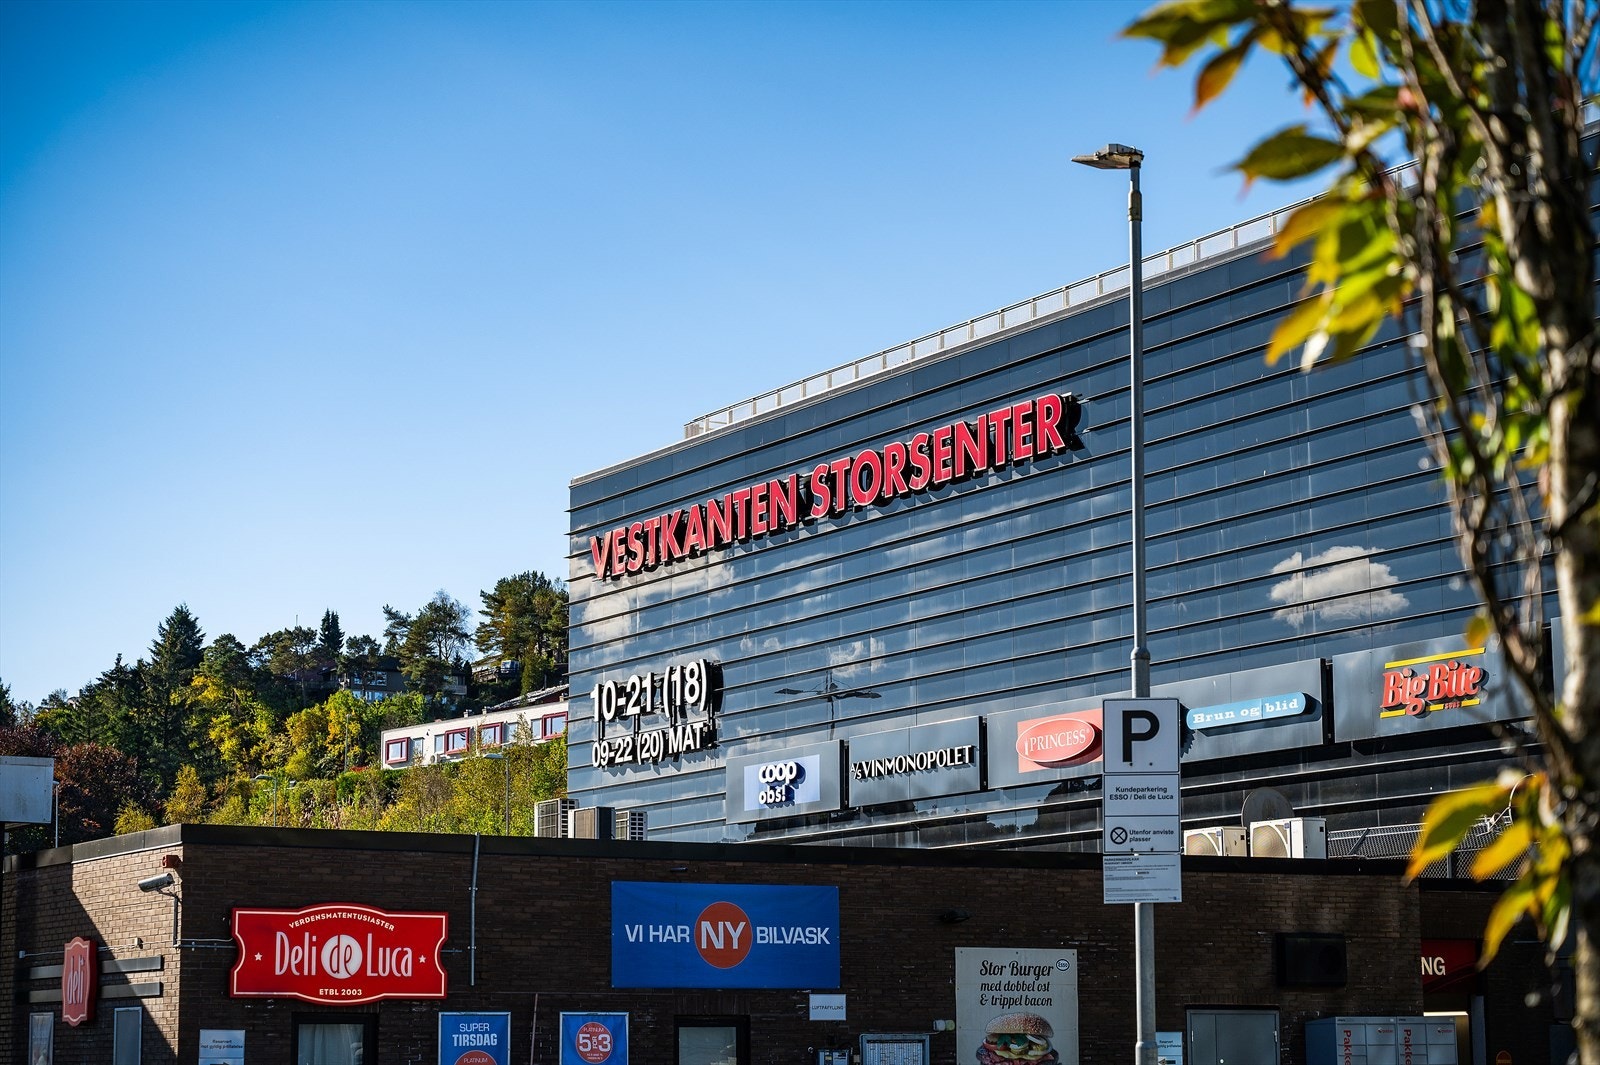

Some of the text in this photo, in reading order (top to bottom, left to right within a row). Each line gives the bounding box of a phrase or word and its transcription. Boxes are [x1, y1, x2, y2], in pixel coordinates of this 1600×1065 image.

[589, 392, 1065, 580] VESTKANTEN STORSENTER
[590, 658, 707, 722] 10-21 (18)
[1380, 660, 1483, 716] Big Bite
[1192, 698, 1299, 724] Brun og blid
[592, 721, 704, 768] 09-22 (20) MAT
[1029, 728, 1087, 752] PRINCESS
[1121, 709, 1161, 763] P
[758, 760, 797, 786] coop
[862, 745, 972, 778] VINMONOPOLET
[758, 784, 787, 805] obs!
[288, 911, 396, 932] VERDENSMATENTUSIASTER
[624, 920, 831, 950] VI HAR NY BILVASK
[274, 930, 413, 978] Deli de Luca
[1420, 956, 1446, 976] NG
[66, 954, 84, 1006] deli
[979, 959, 1054, 982] Stor Burger
[319, 988, 363, 997] ETBL 2003
[980, 980, 1051, 992] med dobbel ost
[979, 993, 1053, 1010] & trippel bacon
[451, 1033, 498, 1047] TIRSDAG
[459, 1022, 491, 1033] SUPER
[578, 1033, 592, 1052] 5
[598, 1033, 611, 1052] 3
